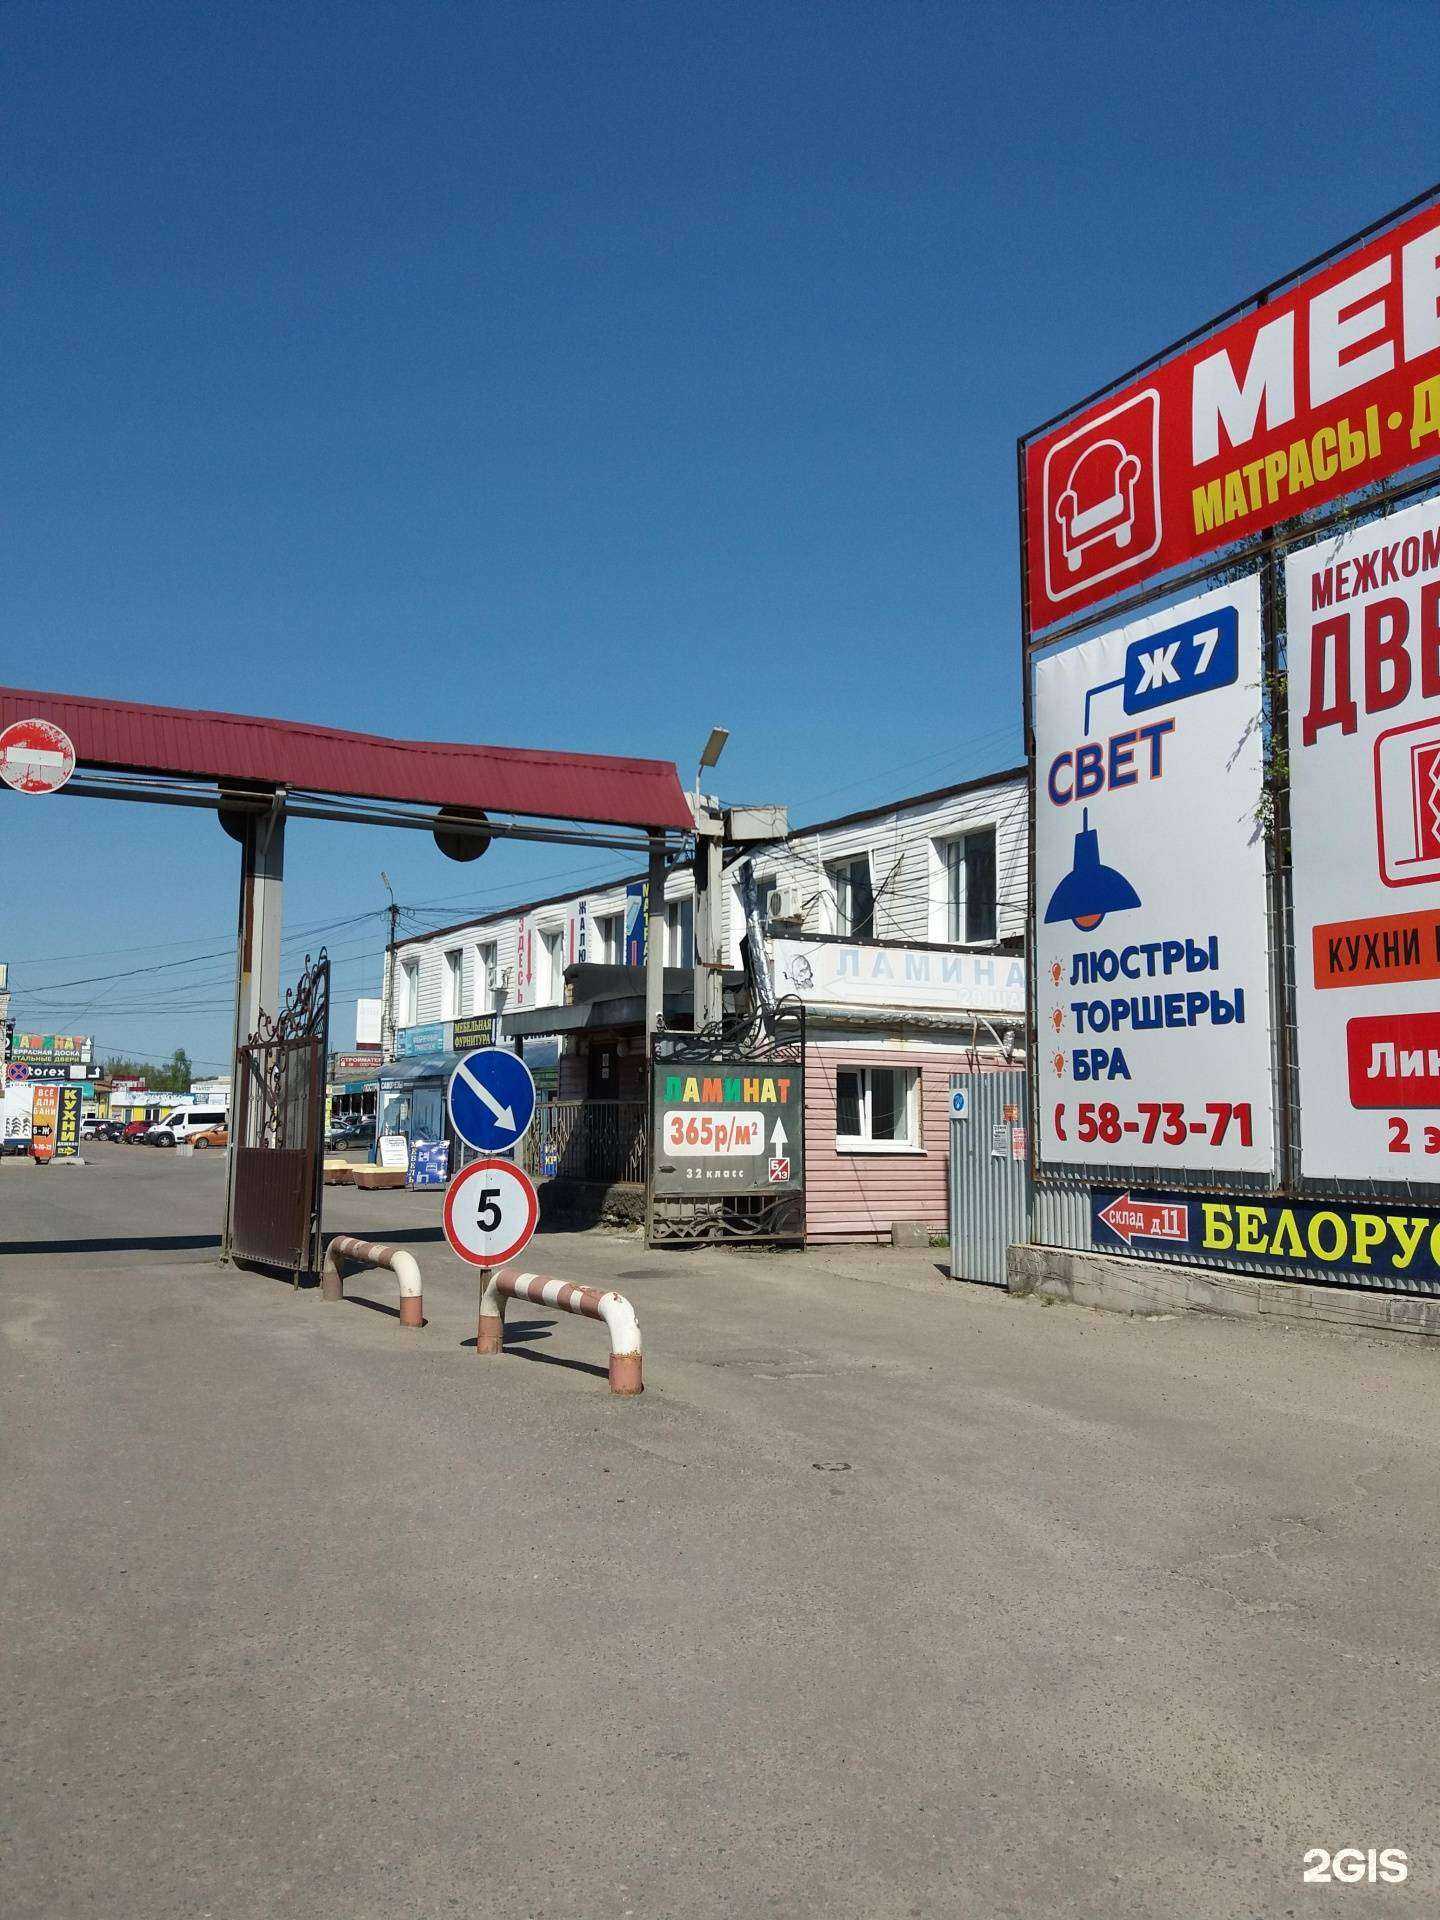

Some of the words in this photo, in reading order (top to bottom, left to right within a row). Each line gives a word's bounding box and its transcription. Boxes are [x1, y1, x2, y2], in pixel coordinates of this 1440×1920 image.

[1192, 405, 1382, 535] МАТРАСЫ
[1135, 641, 1180, 695] Ж
[1193, 628, 1219, 675] 7
[1048, 717, 1176, 806] СВЕТ
[1070, 936, 1220, 986] ЛЮСТРЫ
[1329, 927, 1421, 974] КУХНИ
[1071, 988, 1245, 1034] ТОРШЕРЫ
[54, 1048, 80, 1057] ДОСКА
[1072, 1047, 1132, 1081] БРА
[664, 1076, 791, 1104] ЛАМИНАТ
[60, 1089, 78, 1142] КУХНИ
[1078, 1103, 1253, 1147] 58-73-71
[1388, 1117, 1411, 1153] 2
[686, 1168, 702, 1179] 32
[706, 1168, 745, 1179] класс
[476, 1188, 502, 1233] 5
